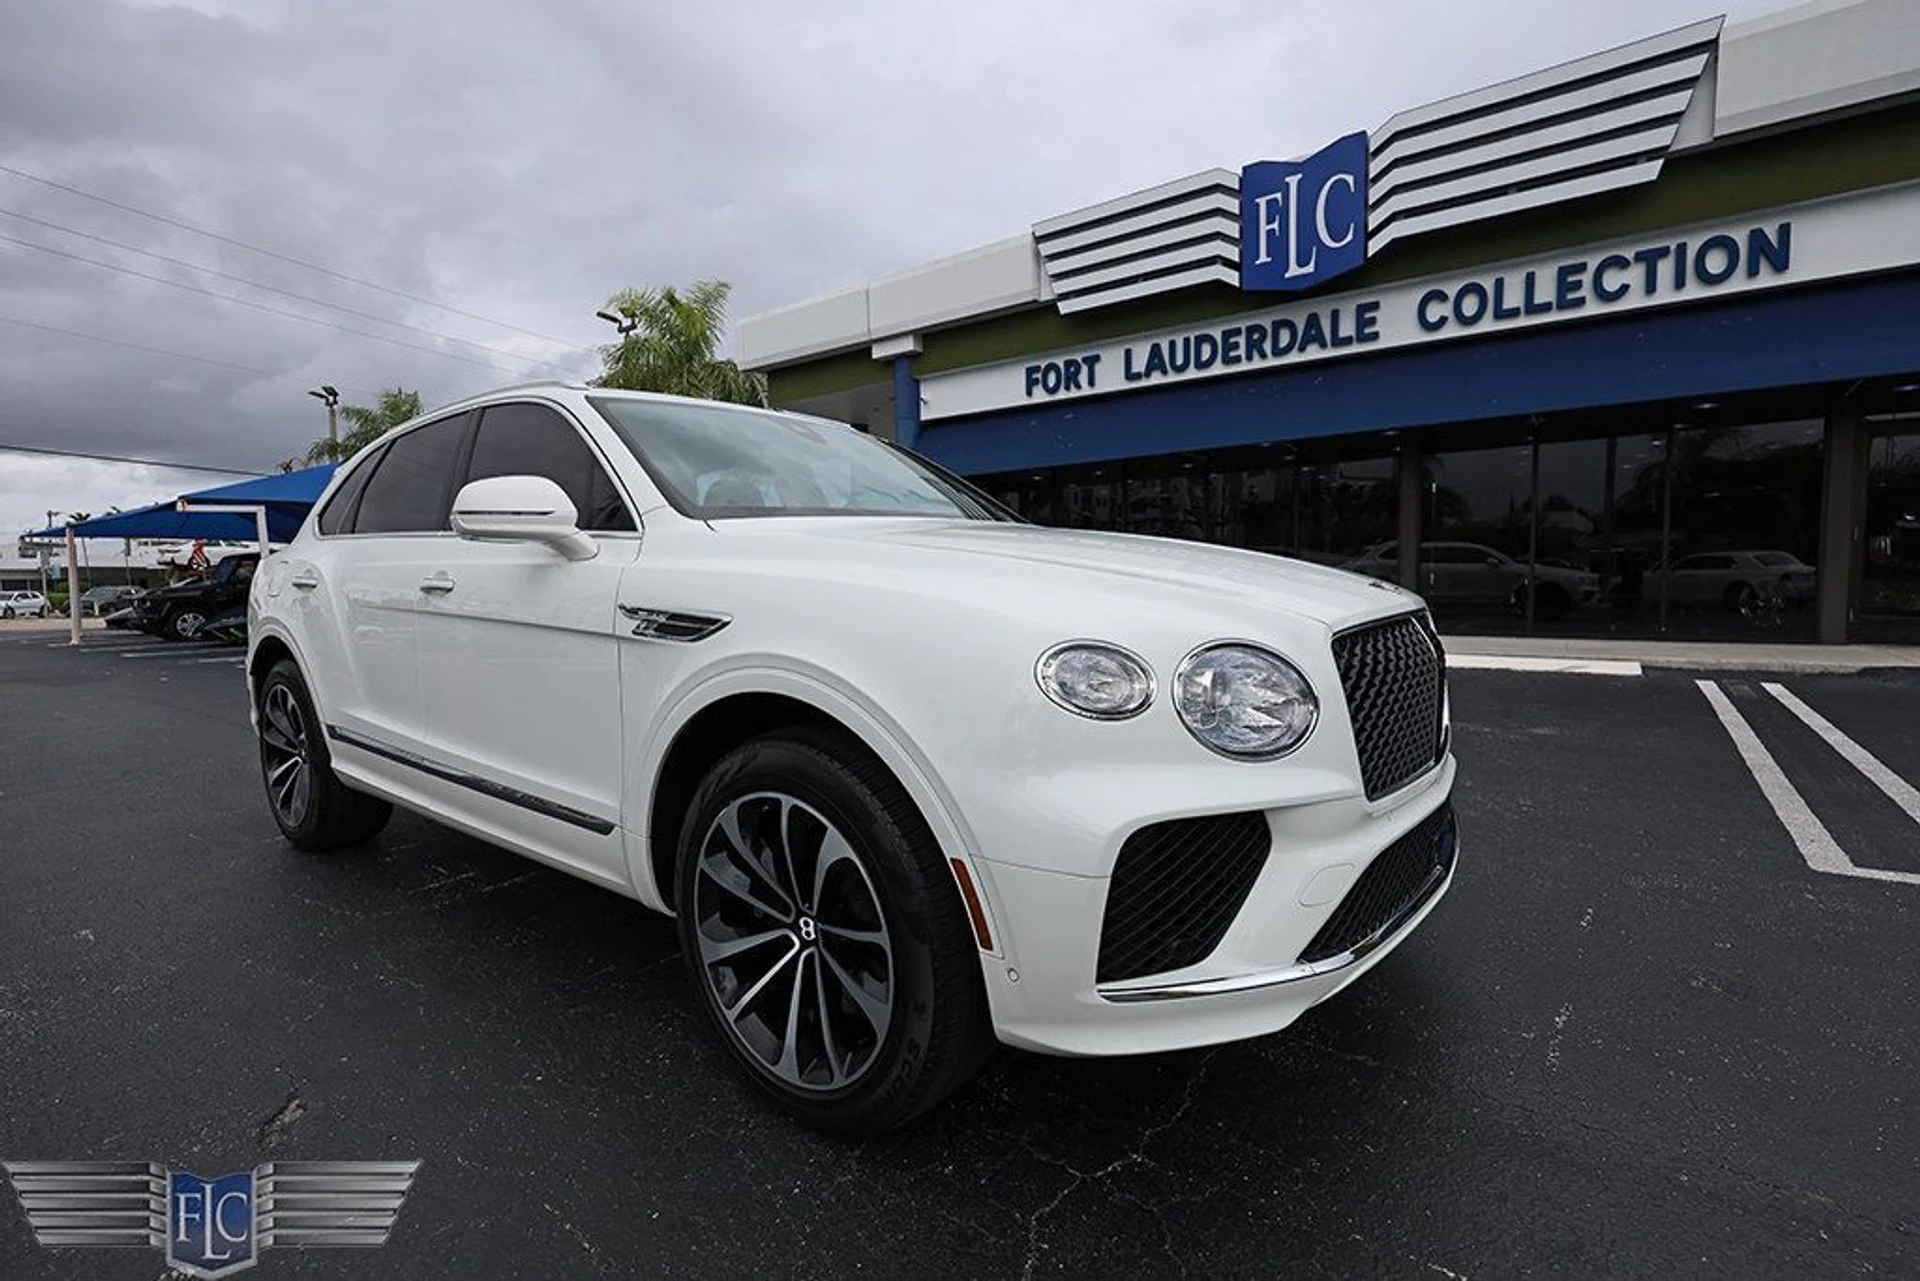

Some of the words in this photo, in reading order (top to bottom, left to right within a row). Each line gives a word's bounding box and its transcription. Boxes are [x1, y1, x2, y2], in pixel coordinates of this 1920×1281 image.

[1255, 173, 1355, 279] FLC
[1024, 353, 1101, 398] FORT
[1123, 300, 1381, 382] LAUDERDALE
[1417, 221, 1792, 332] COLLECTION
